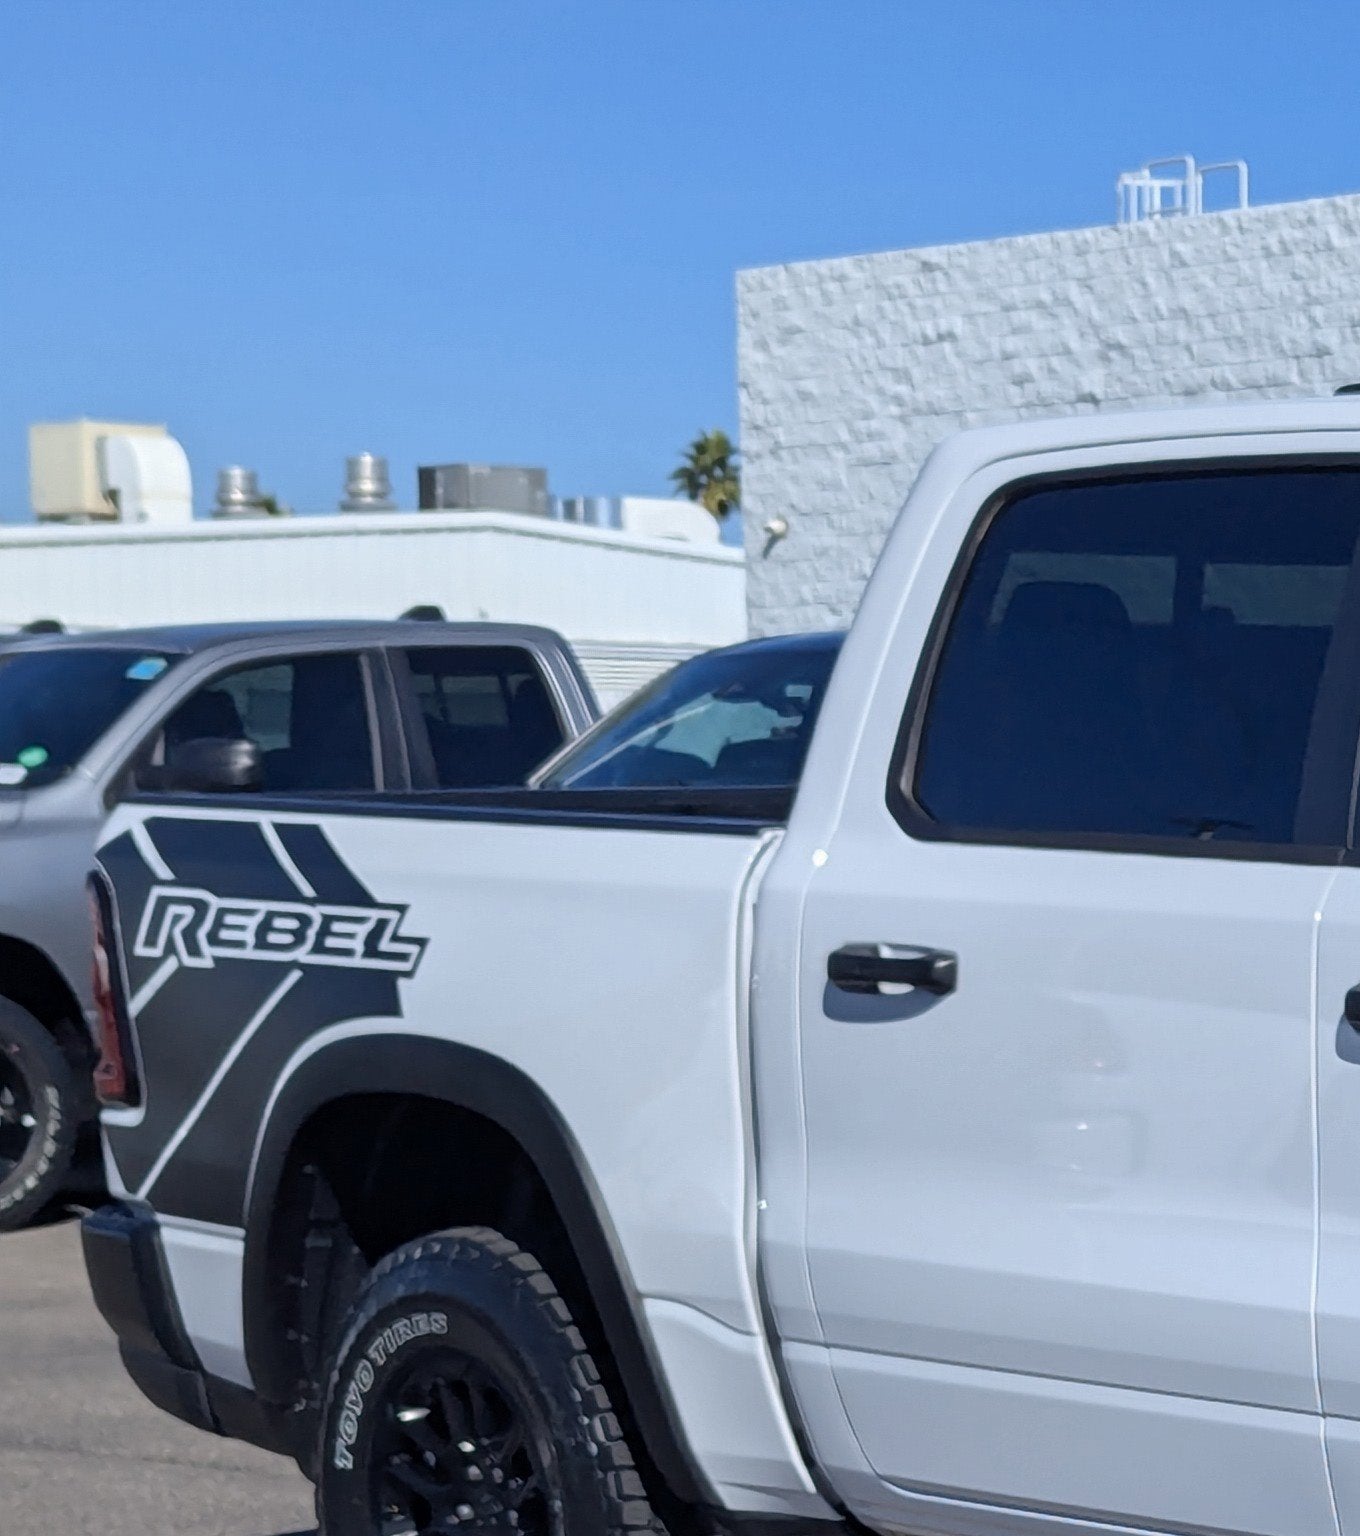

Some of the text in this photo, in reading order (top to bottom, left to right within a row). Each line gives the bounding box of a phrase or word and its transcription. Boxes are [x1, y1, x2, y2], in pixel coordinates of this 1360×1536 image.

[133, 885, 426, 974] REBEL
[334, 1311, 449, 1470] TOYO TIRES
